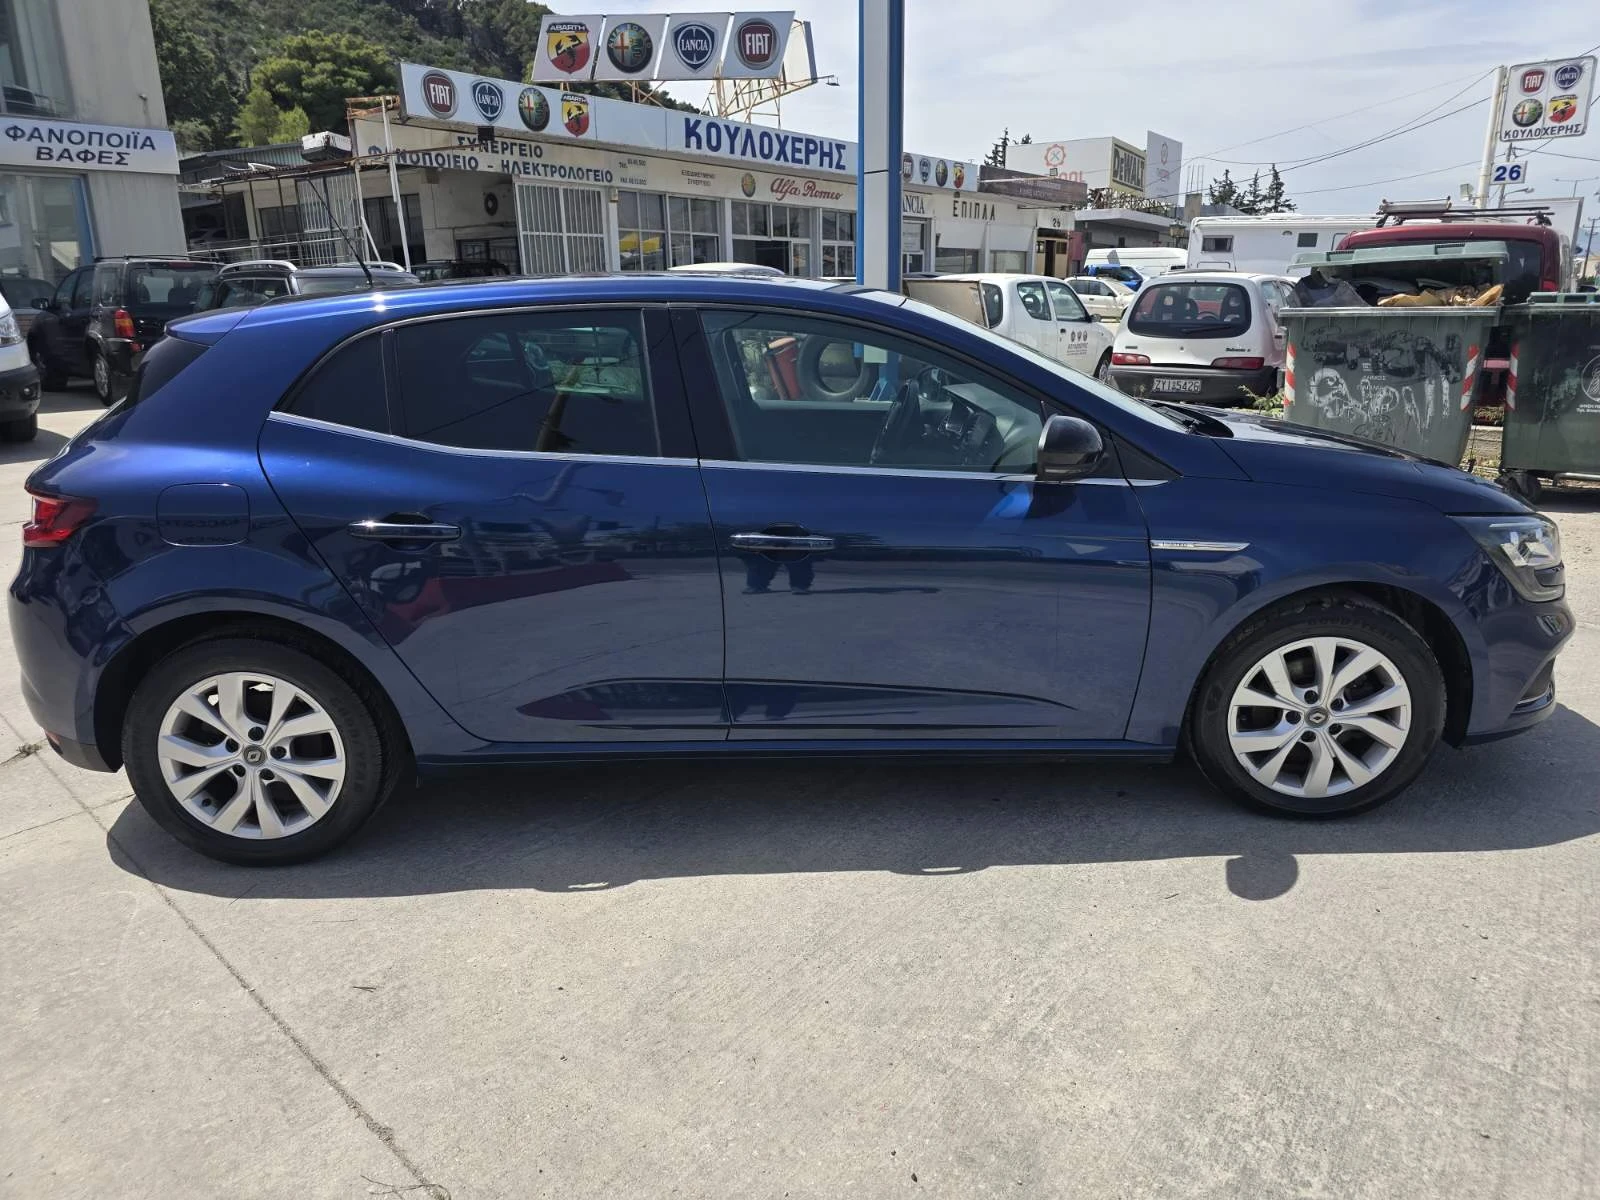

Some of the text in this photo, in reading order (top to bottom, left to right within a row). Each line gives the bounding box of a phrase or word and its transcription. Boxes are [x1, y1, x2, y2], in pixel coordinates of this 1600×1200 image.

[680, 38, 709, 52] LANCIA
[745, 33, 770, 55] FIAT
[1524, 74, 1543, 89] FIAT
[429, 83, 451, 106] FIAT
[478, 93, 500, 108] LANCIA
[5, 125, 156, 151] ΦΑΝΟΠΟΙΪΑ
[1503, 123, 1582, 139] ΚΟΥΛΟΧΕΡΗΣ
[684, 117, 847, 171] ΚΟΥΛΟΧΕΡΗΣ
[36, 146, 131, 166] ΒΑΦΕΣ
[501, 159, 613, 183] ΗΛΕΚΤΡΟΛΟΓΕΙΟ
[1493, 164, 1522, 182] 26
[769, 177, 844, 201] Alfa Romeo
